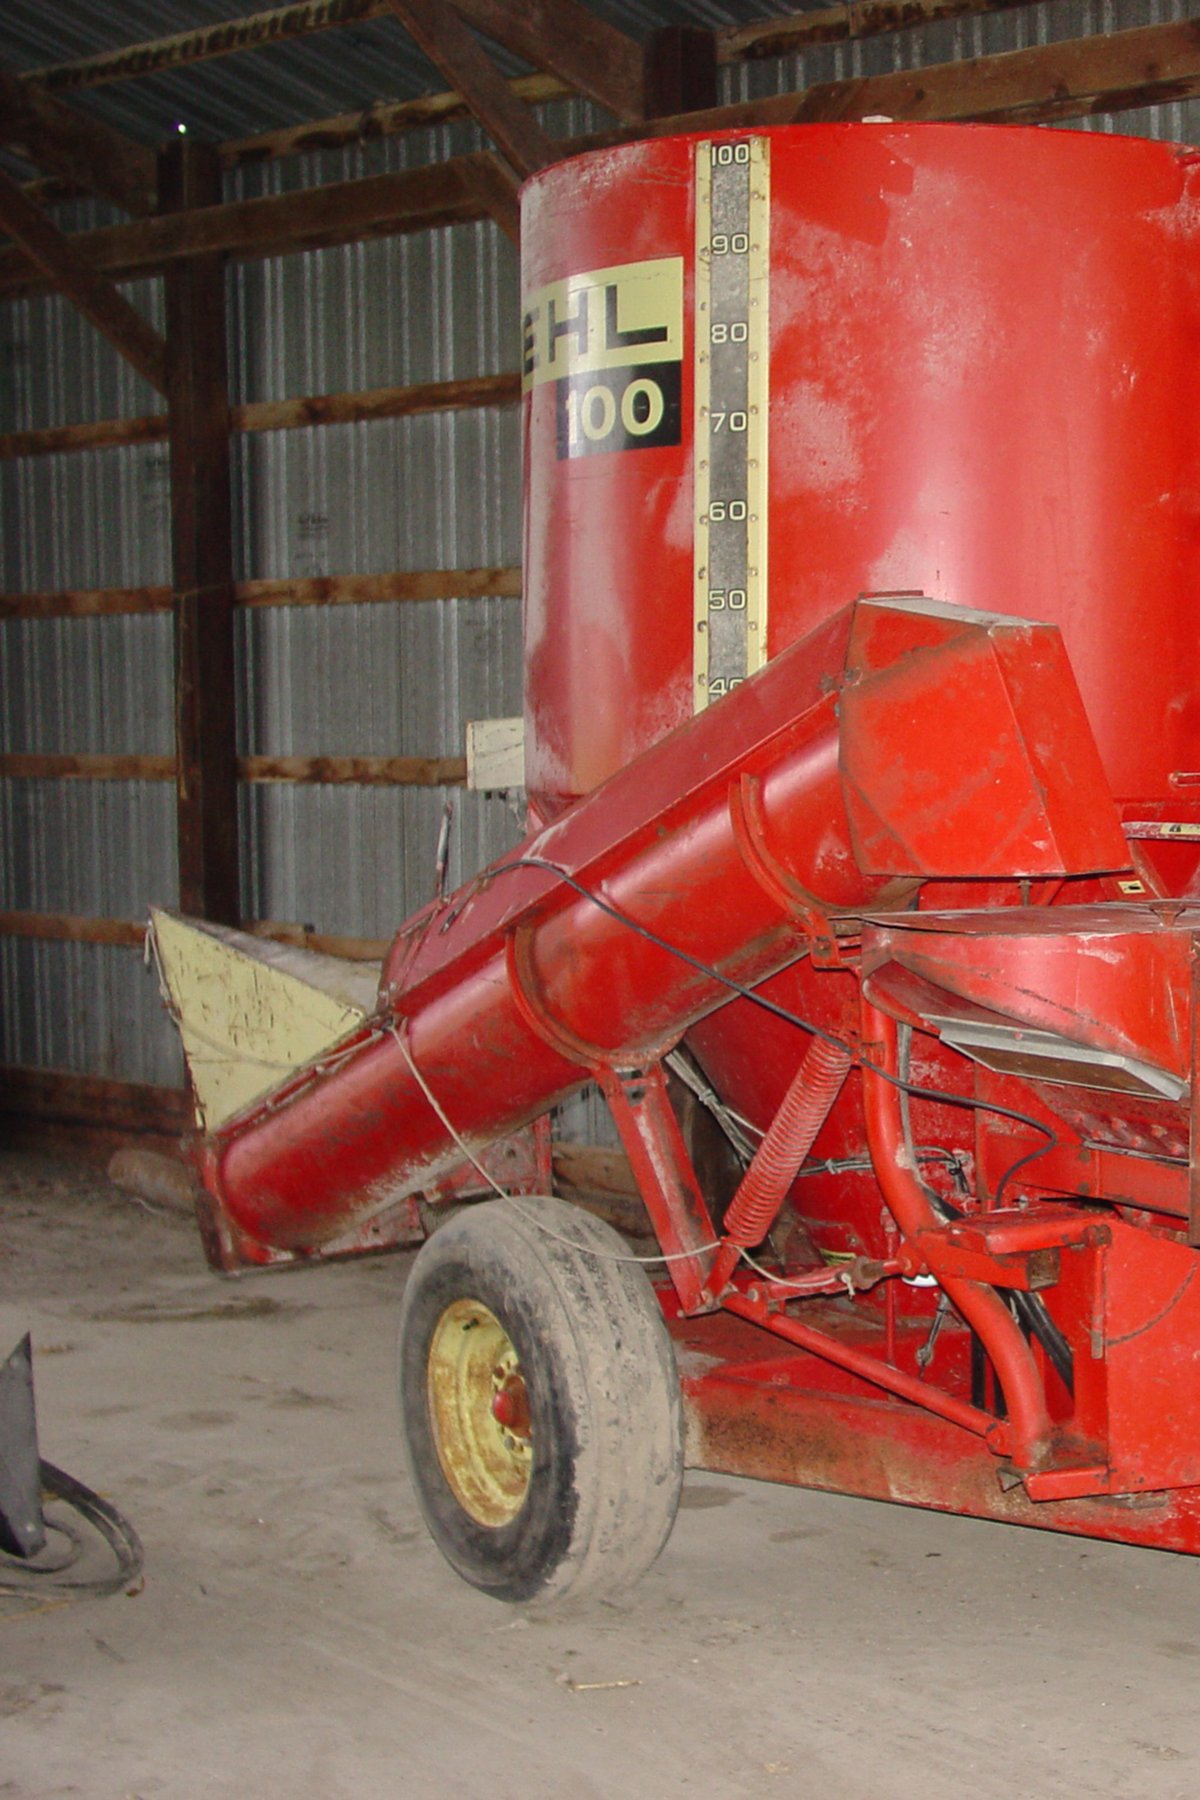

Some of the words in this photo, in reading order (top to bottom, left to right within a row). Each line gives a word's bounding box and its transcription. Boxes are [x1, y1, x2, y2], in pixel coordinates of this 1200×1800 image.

[711, 144, 750, 166] 100
[711, 234, 749, 255] 90
[711, 323, 749, 344] 80
[565, 378, 664, 444] 100
[710, 412, 748, 433] 70
[709, 502, 747, 522] 60
[709, 590, 746, 610] 50
